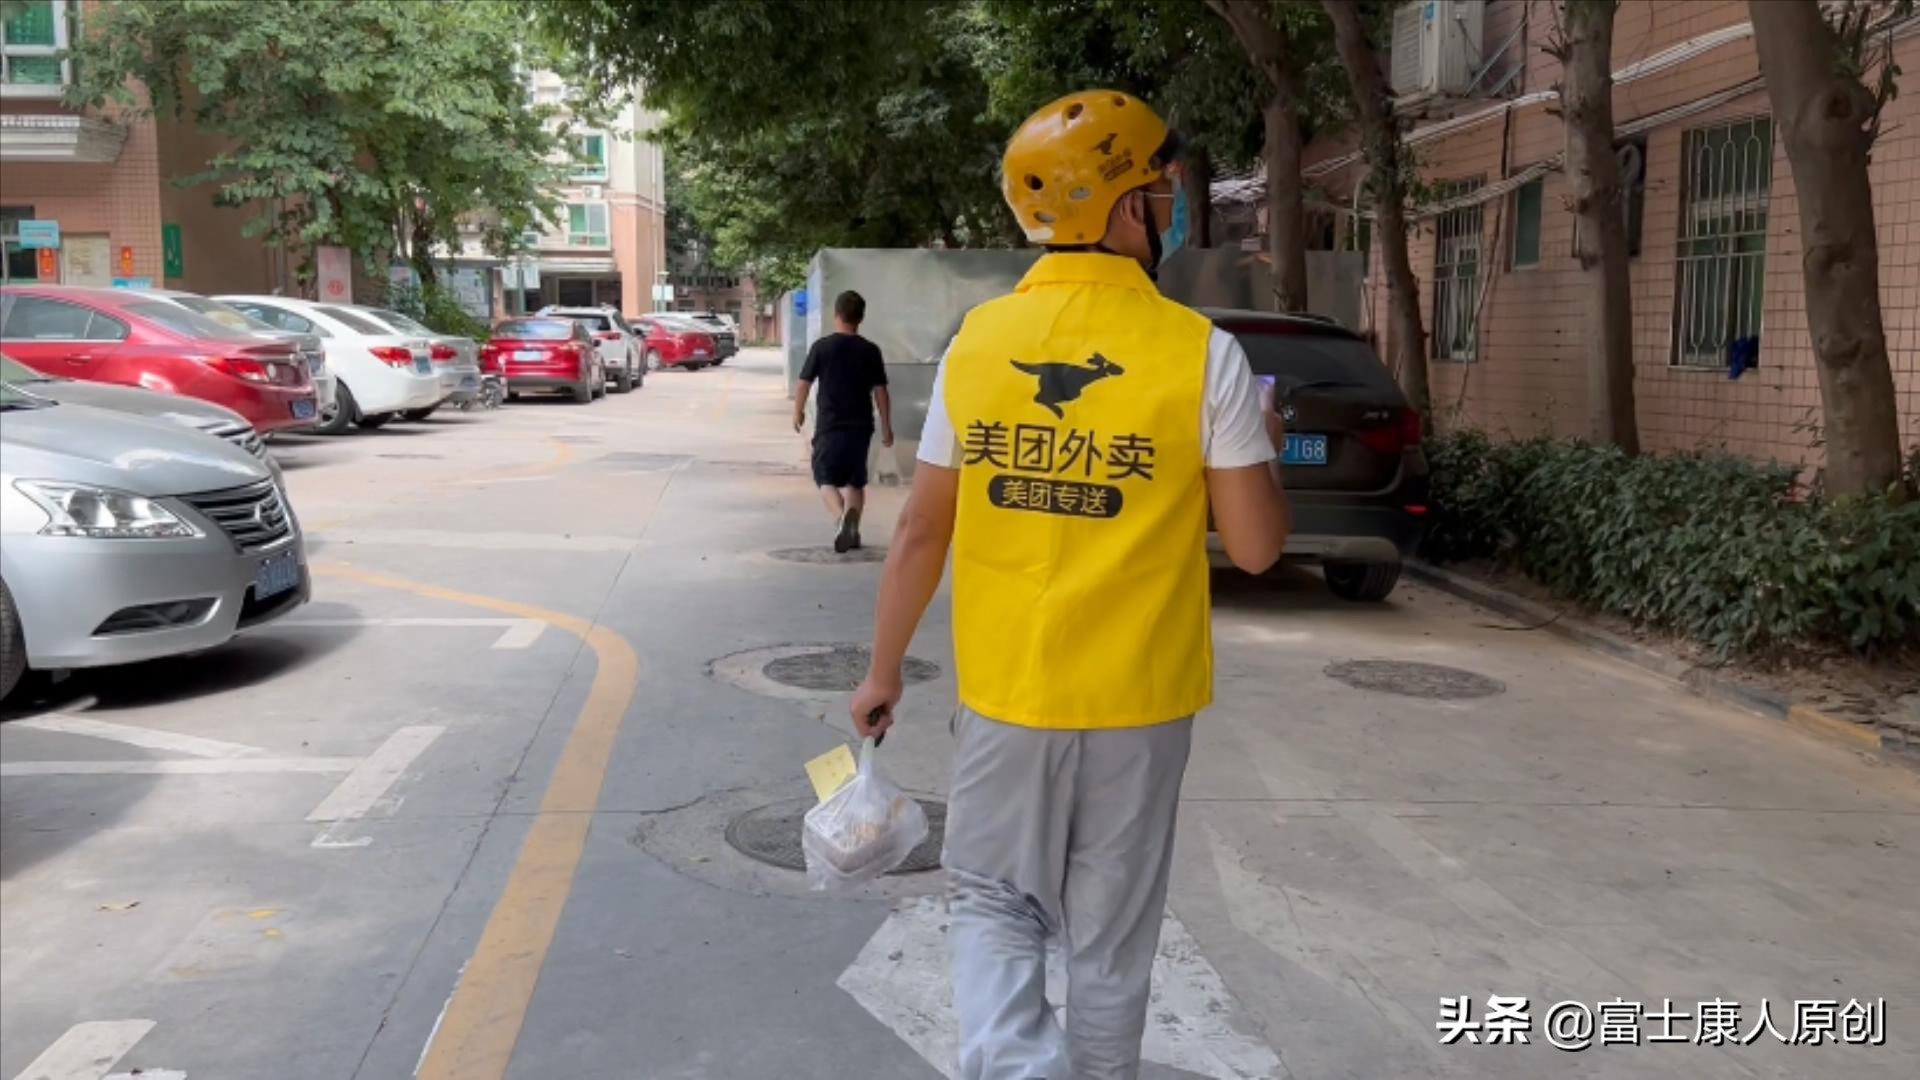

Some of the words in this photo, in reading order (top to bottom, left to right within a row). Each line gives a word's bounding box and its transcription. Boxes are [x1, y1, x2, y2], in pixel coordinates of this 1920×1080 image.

[964, 420, 1155, 481] 美团外卖
[1001, 479, 1109, 516] 美团专送
